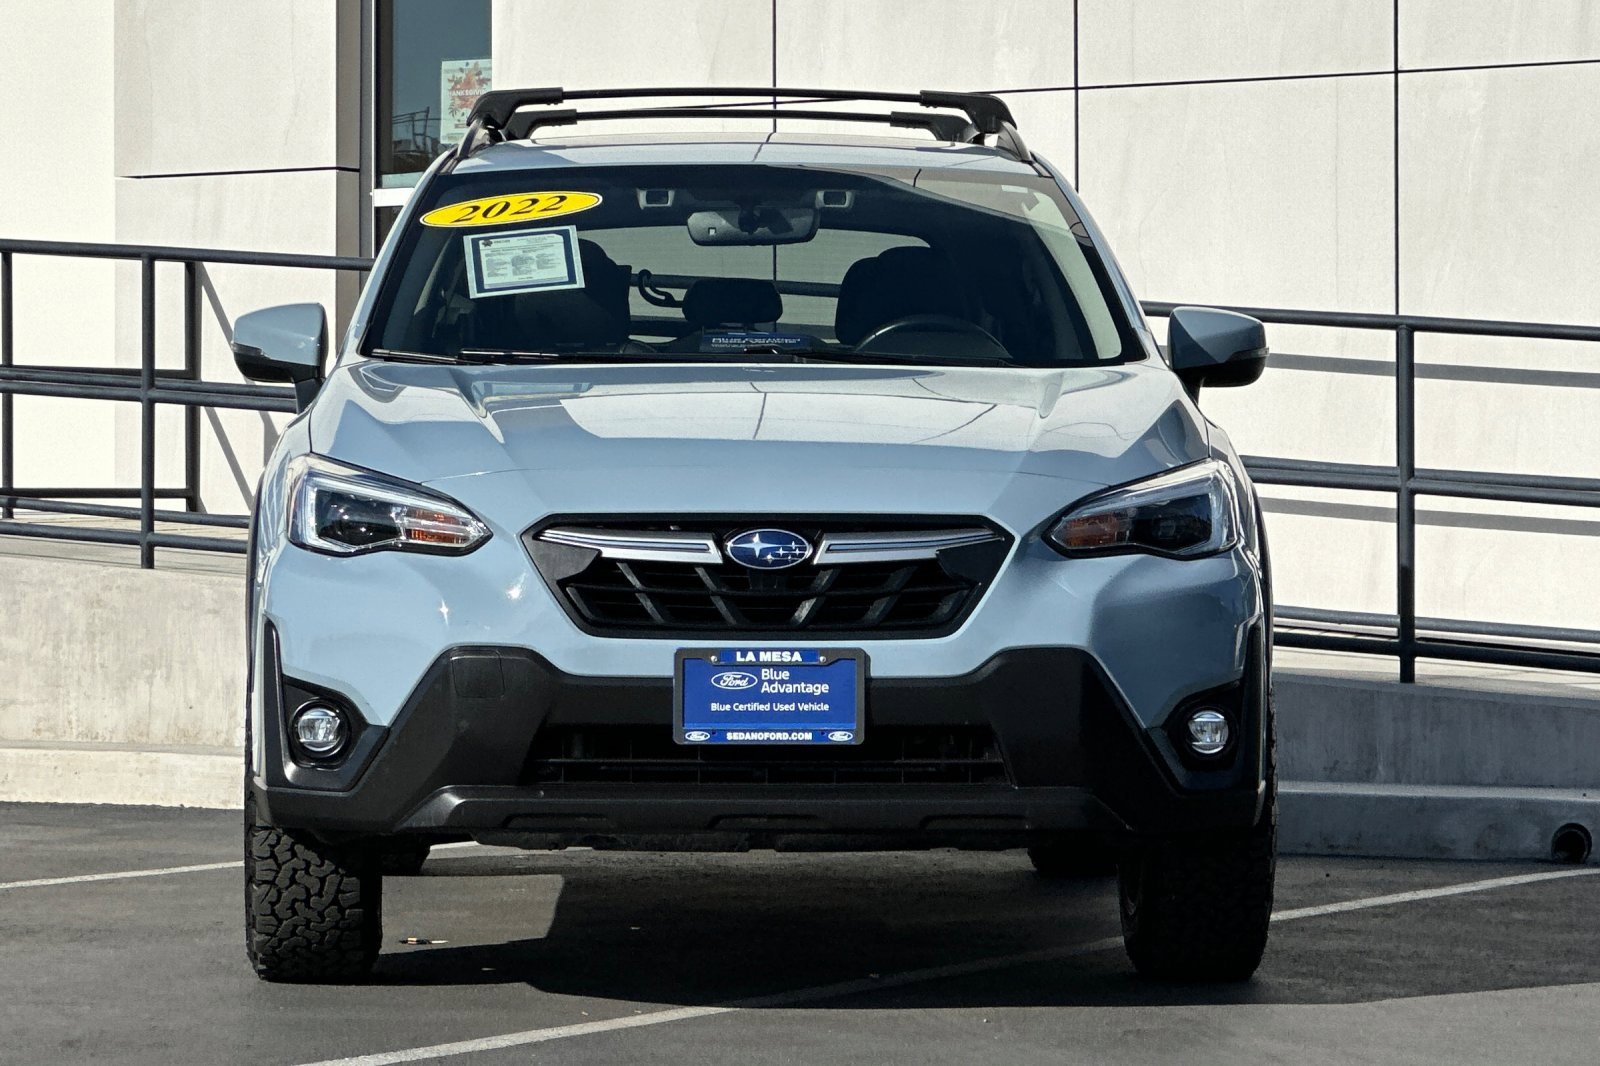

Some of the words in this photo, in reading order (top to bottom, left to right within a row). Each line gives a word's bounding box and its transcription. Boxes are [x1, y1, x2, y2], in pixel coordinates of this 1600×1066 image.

[450, 195, 568, 223] 2022
[736, 651, 756, 662] LA
[759, 651, 803, 662] MESA
[761, 669, 790, 680] Blue
[719, 674, 749, 687] Ford
[761, 682, 830, 695] Advantage
[710, 703, 731, 712] Blue
[733, 702, 770, 712] Certified
[773, 703, 796, 712] Used
[798, 702, 830, 712] Vehicle
[726, 732, 813, 741] SEDANOFORD.COM
